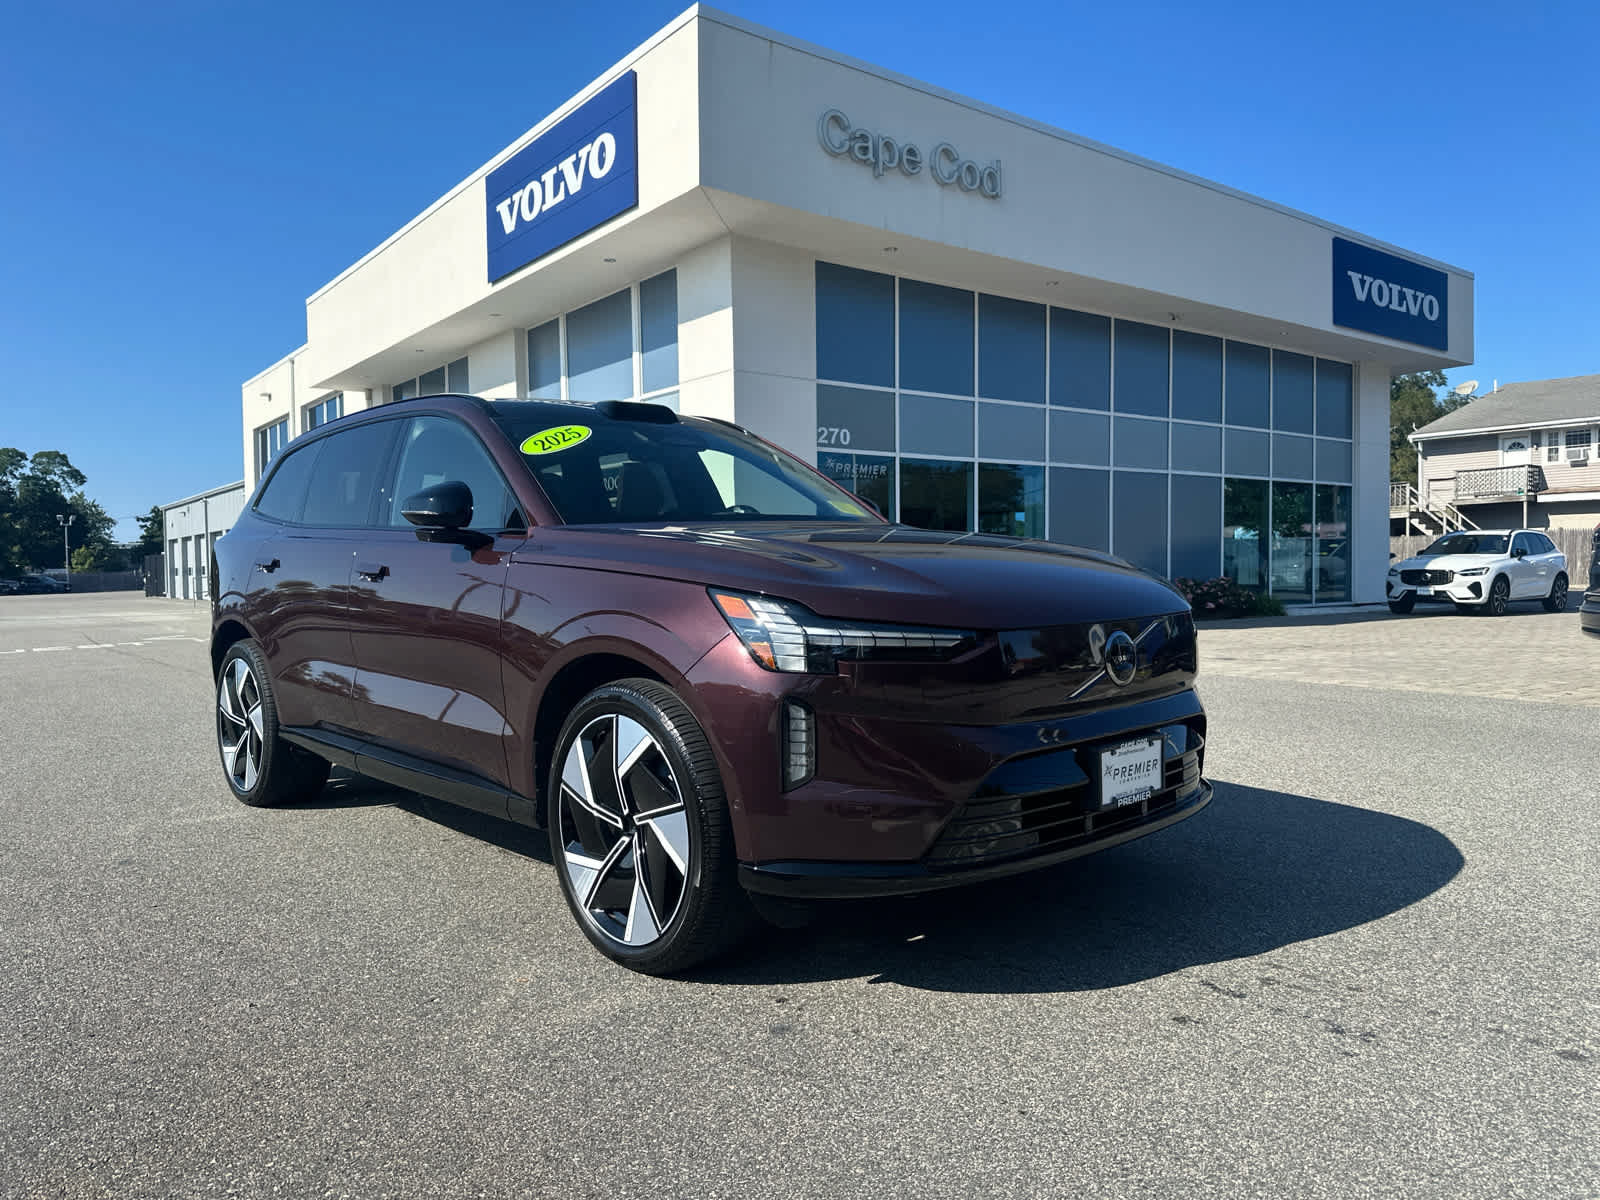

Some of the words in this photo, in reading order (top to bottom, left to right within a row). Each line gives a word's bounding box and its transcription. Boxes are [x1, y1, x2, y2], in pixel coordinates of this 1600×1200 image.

[820, 109, 923, 178] Cape
[931, 142, 1001, 199] Cod
[496, 133, 617, 235] VOLVO
[1347, 271, 1440, 321] VOLVO
[533, 427, 583, 451] 2025
[818, 427, 850, 445] 270
[835, 463, 887, 475] PREMIER
[1113, 759, 1158, 780] PREMIER
[1118, 791, 1151, 808] PREMIER
